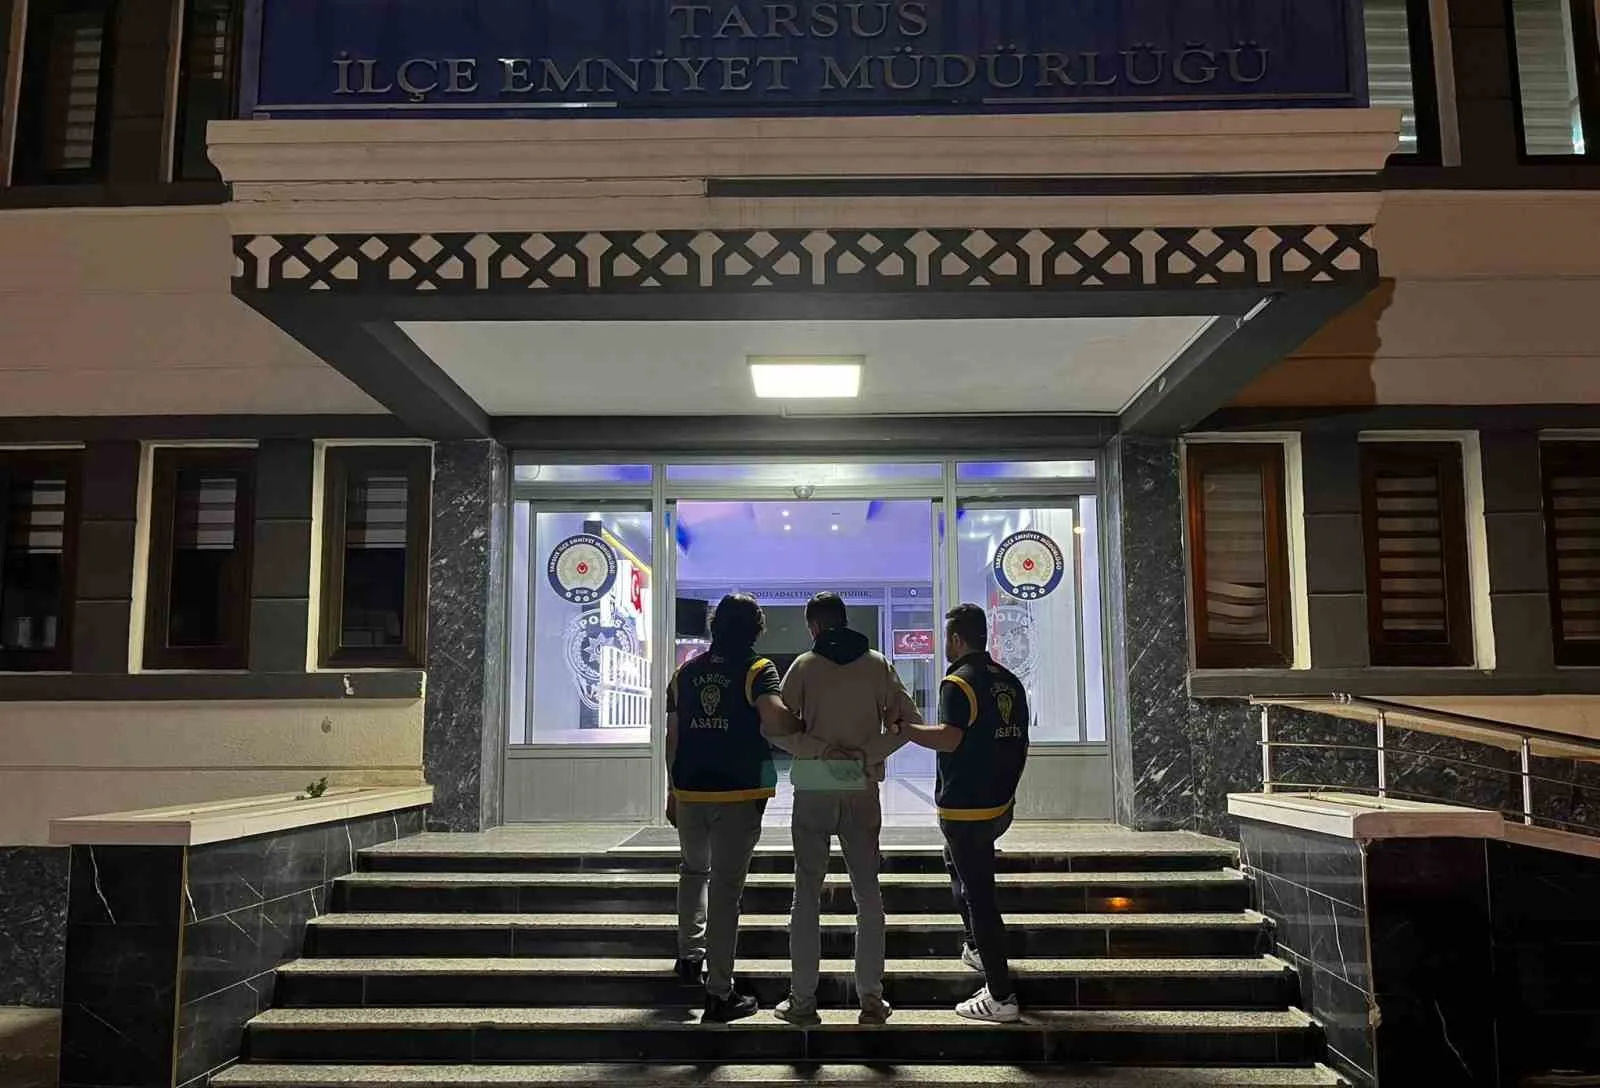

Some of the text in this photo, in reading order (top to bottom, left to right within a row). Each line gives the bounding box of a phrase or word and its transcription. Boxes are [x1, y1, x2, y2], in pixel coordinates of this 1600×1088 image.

[669, 2, 929, 39] TARSUS
[331, 40, 1271, 102] İLÇE EMNİYET MÜDÜRLÜĞÜ
